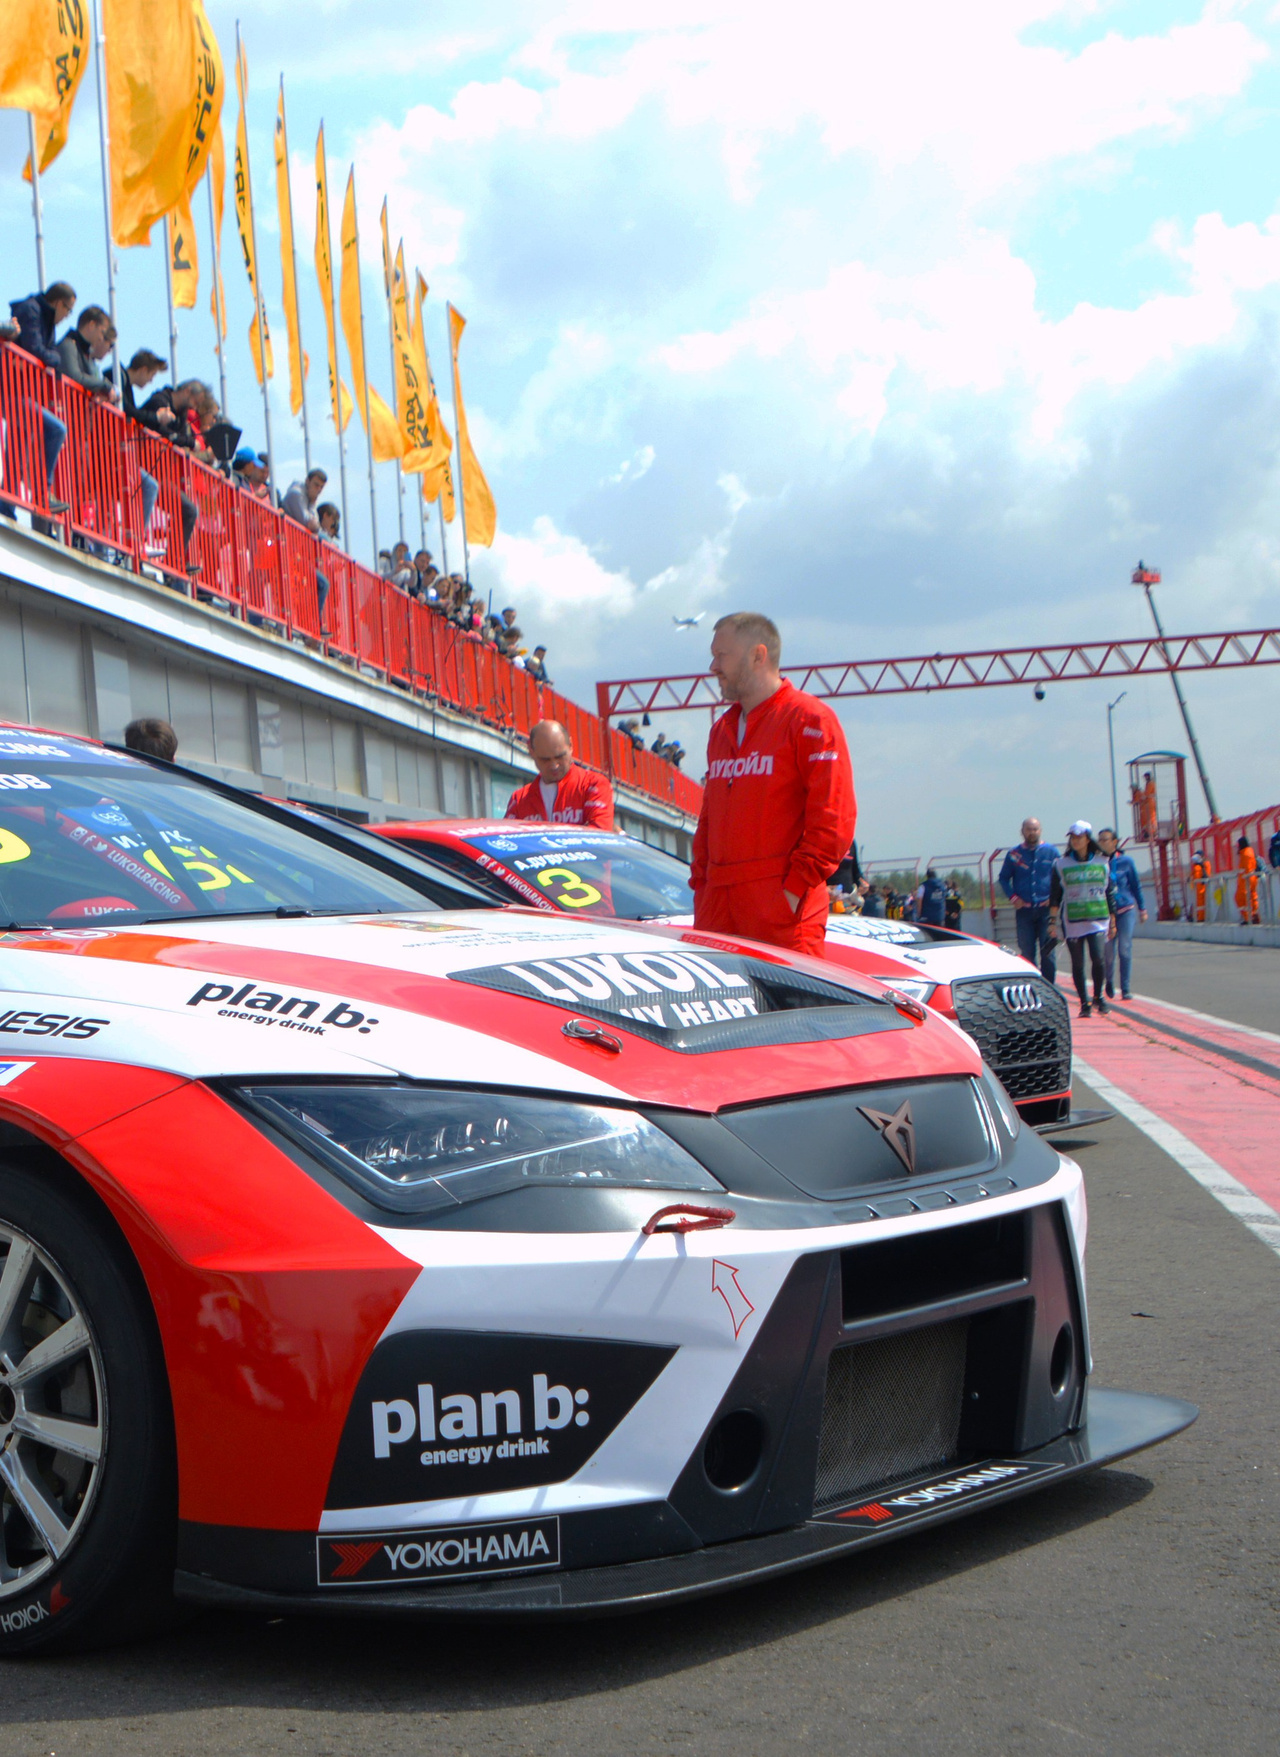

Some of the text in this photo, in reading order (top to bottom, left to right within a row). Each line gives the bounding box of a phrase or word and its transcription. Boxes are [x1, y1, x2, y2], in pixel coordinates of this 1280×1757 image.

[107, 849, 181, 904] LUKOILRACING
[537, 868, 601, 908] 3
[501, 952, 748, 1002] LUKOIL
[186, 982, 379, 1034] plan b:
[217, 1009, 326, 1036] energy drink
[670, 997, 759, 1027] HEART
[372, 1373, 590, 1459] plan b:
[420, 1437, 550, 1465] energy drink
[880, 1466, 1028, 1506] YOKOHAMA
[384, 1530, 549, 1570] YOKOHAMA
